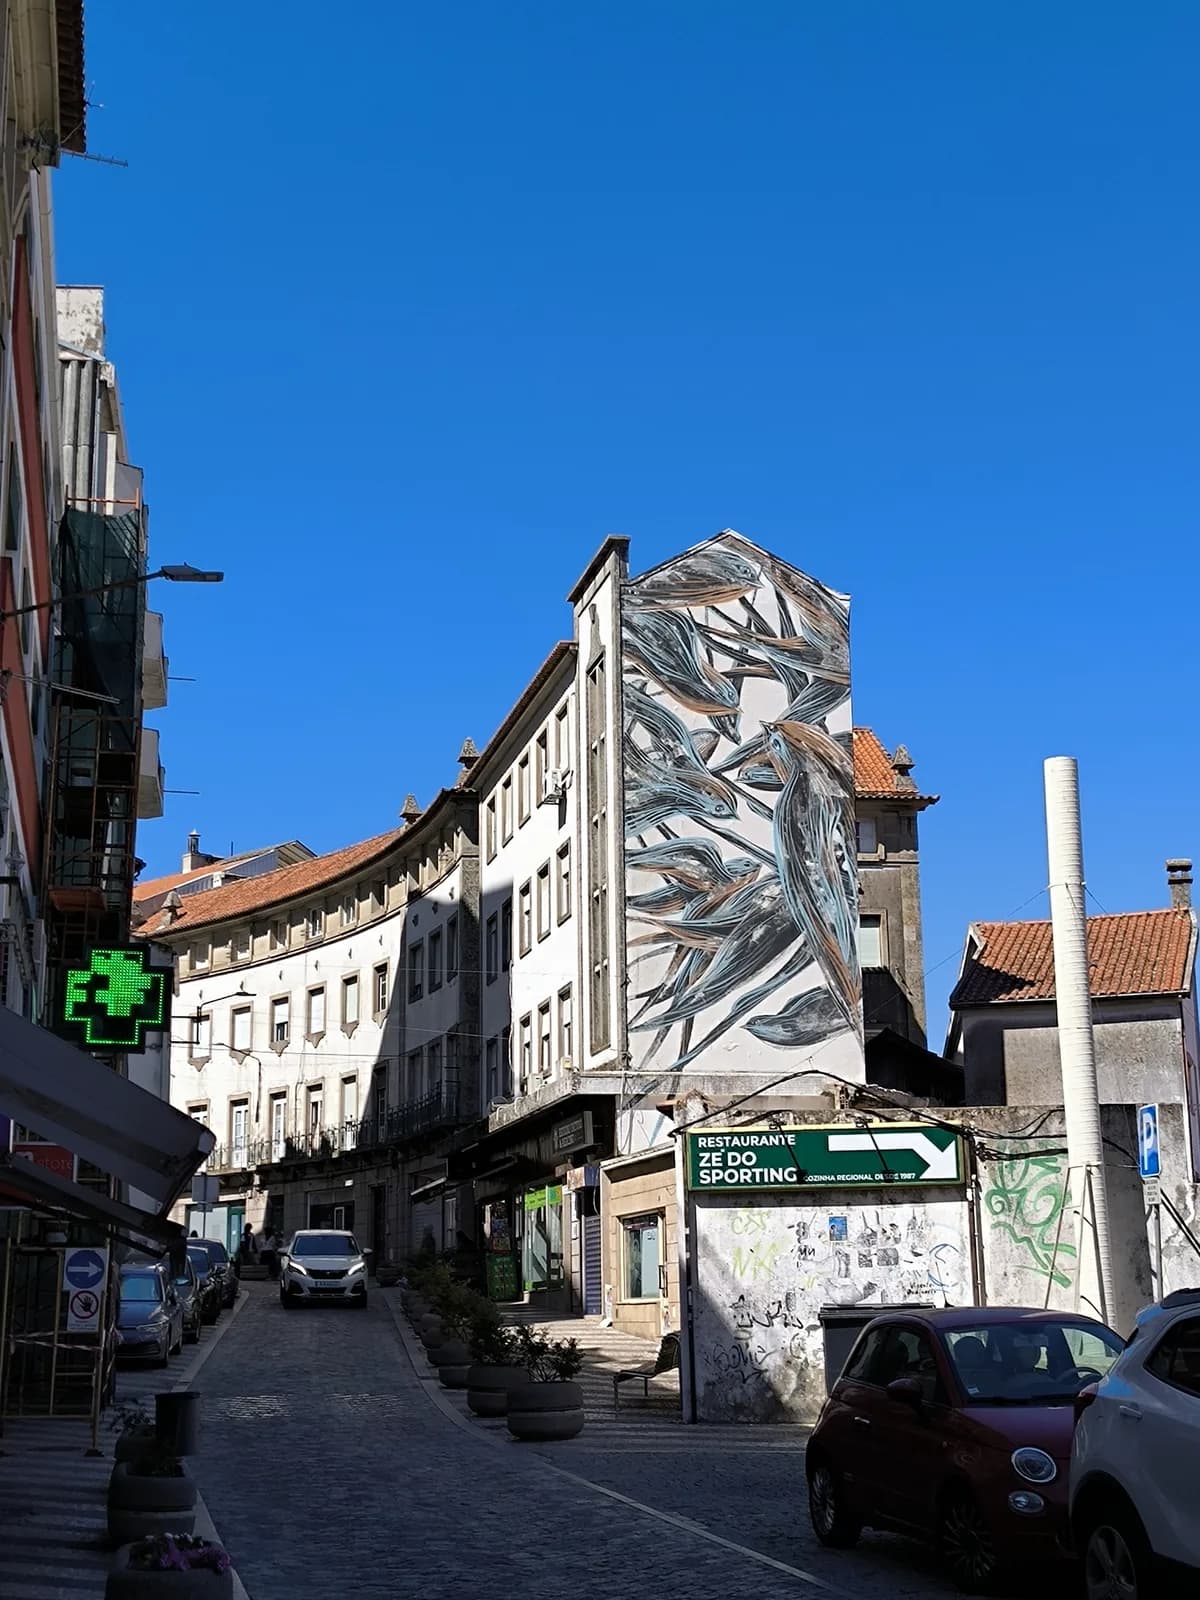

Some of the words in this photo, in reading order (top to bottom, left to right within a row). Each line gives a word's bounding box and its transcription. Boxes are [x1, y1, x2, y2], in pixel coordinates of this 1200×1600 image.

[698, 1134, 796, 1148] RESTAURANTE
[1142, 1112, 1154, 1171] P
[699, 1149, 723, 1167] ZÉ
[727, 1151, 757, 1166] DO
[699, 1167, 798, 1184] SPORTING
[836, 1173, 872, 1181] REGIONAL
